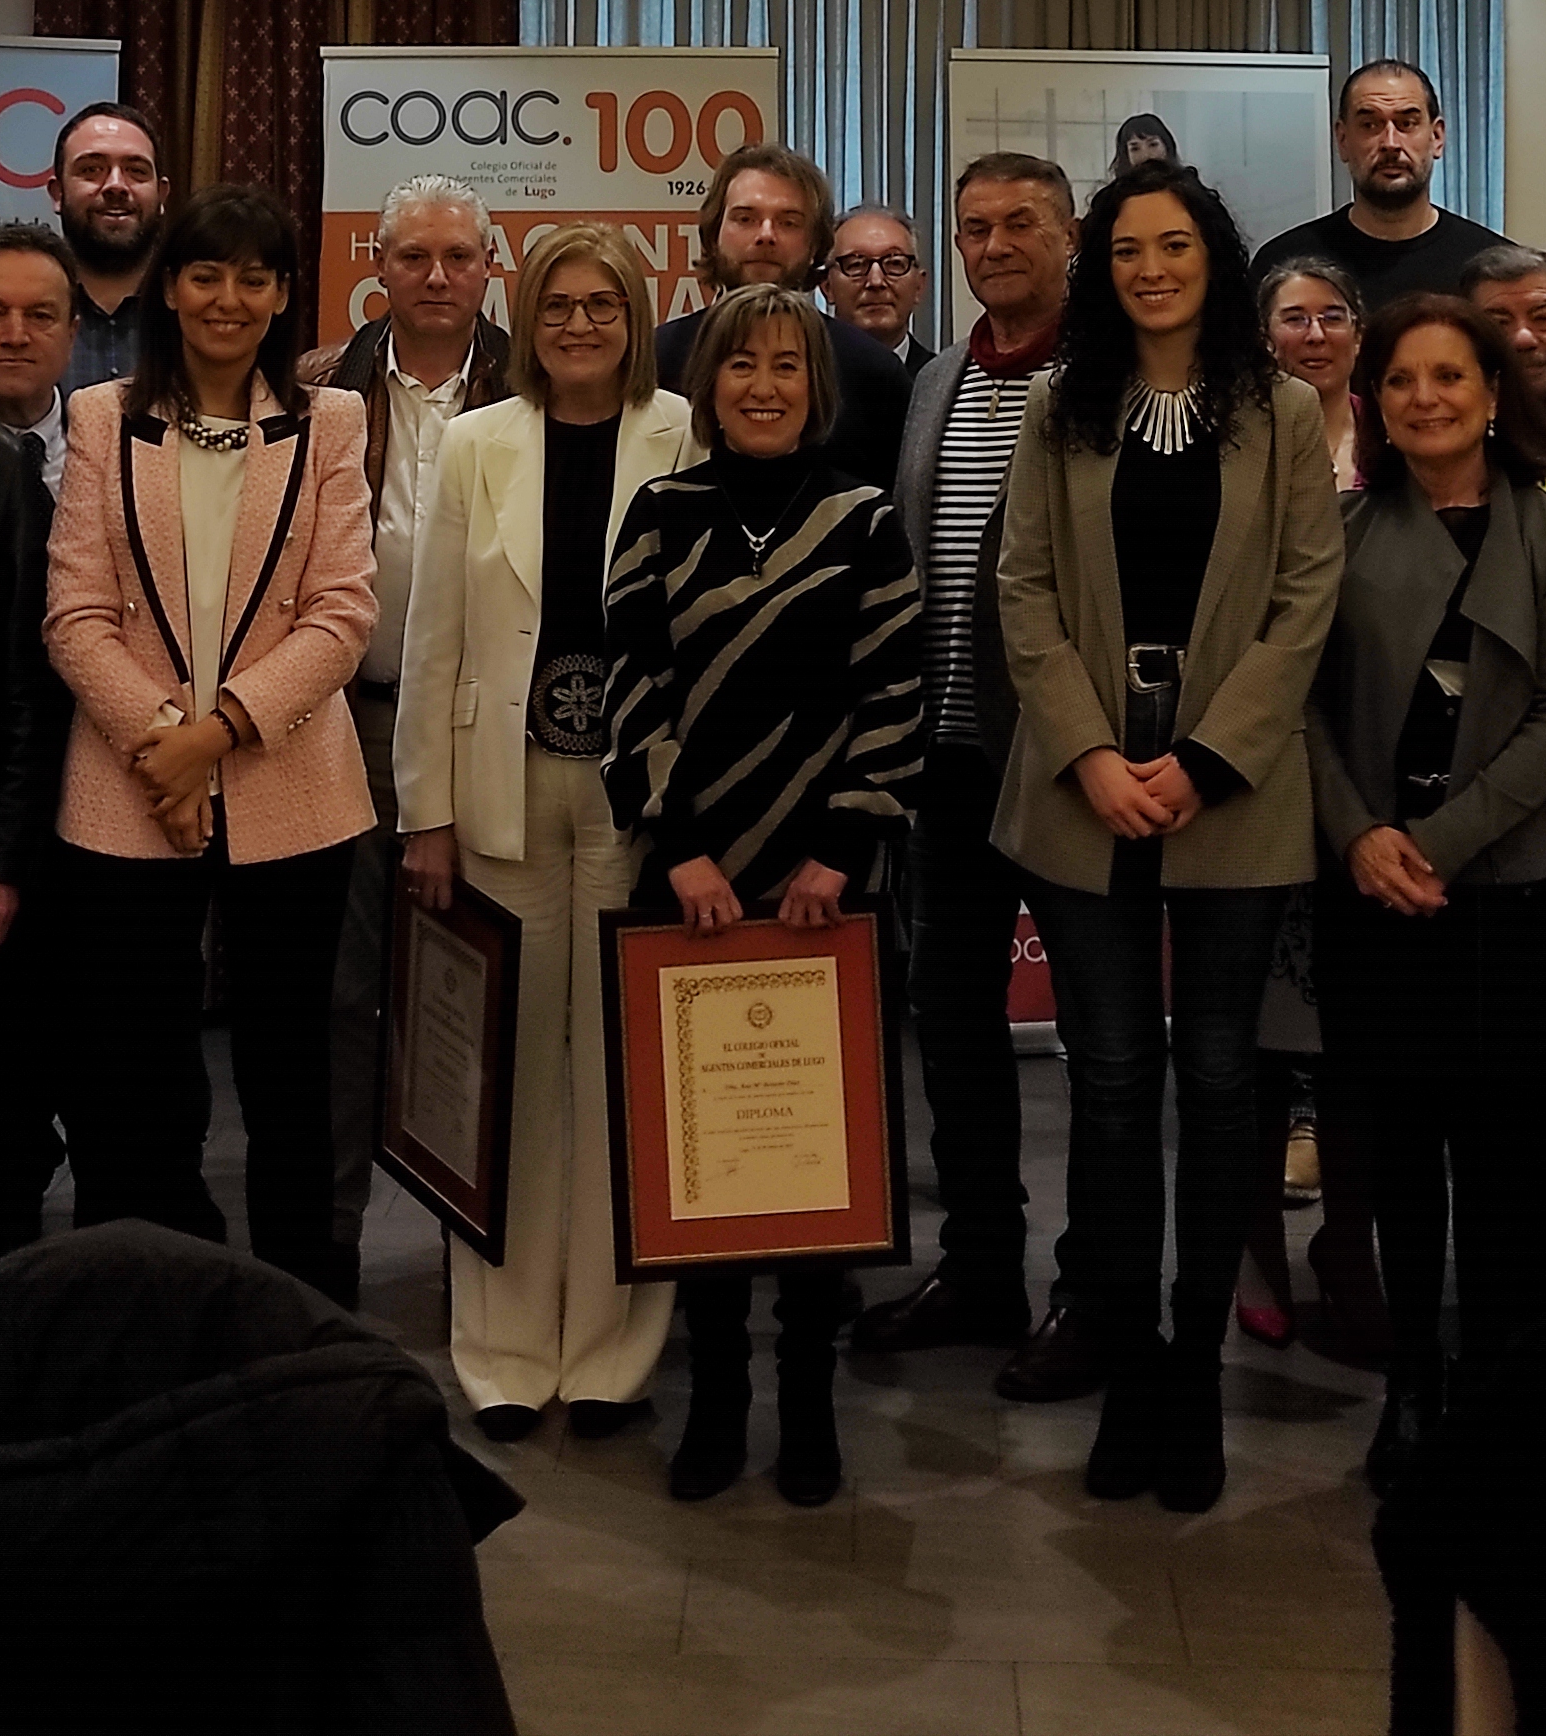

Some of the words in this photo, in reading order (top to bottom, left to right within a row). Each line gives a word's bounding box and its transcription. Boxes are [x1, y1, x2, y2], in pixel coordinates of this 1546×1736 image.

[584, 89, 766, 175] 100
[470, 160, 508, 173] Colegio
[510, 160, 543, 171] Oficial
[545, 161, 557, 171] de
[497, 173, 557, 184] Comerciales
[505, 187, 517, 197] de
[524, 185, 556, 199] Lugo
[701, 1062, 735, 1073] AGENTES
[737, 1059, 790, 1071] COMERCIALES
[736, 1107, 794, 1120] DIPLOMA
